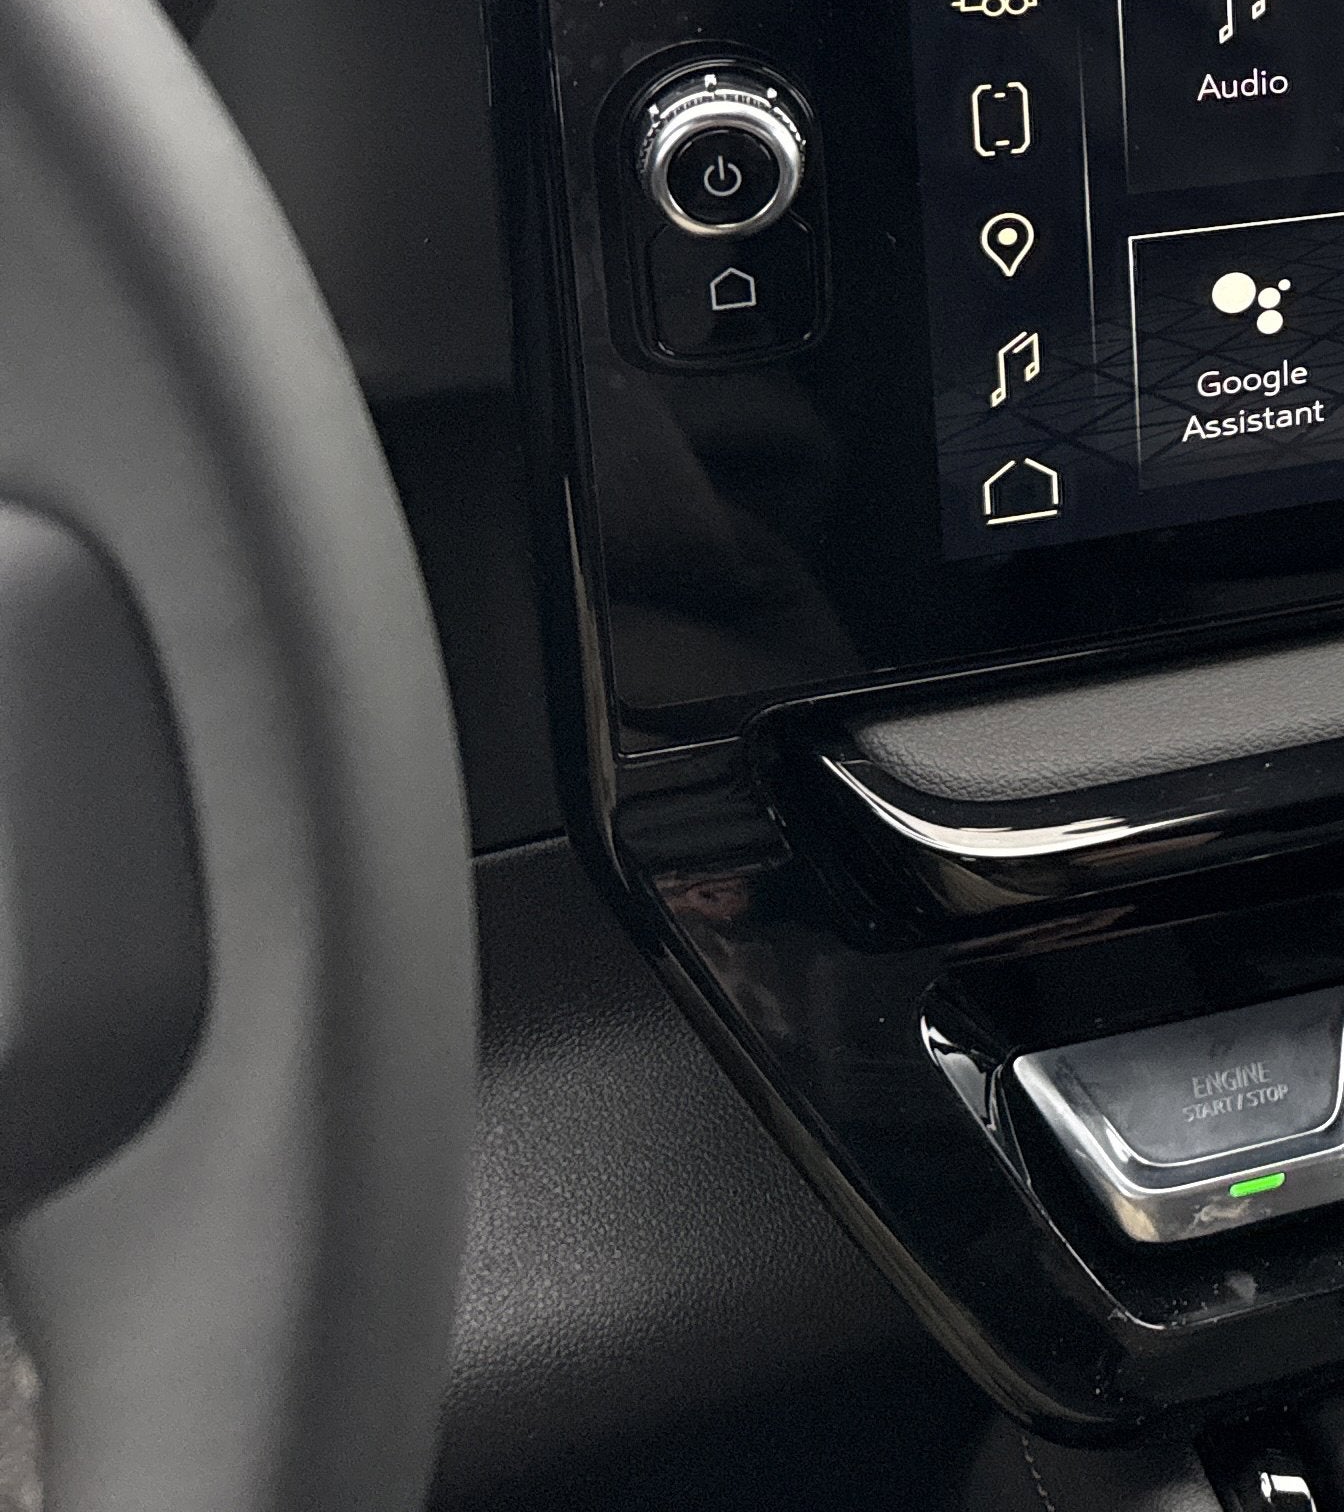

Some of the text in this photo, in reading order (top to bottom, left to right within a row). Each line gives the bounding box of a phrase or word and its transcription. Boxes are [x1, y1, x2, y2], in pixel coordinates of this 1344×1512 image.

[1196, 68, 1290, 102] Audio
[1196, 359, 1309, 399] Google
[1181, 399, 1326, 444] Assistant
[1192, 1062, 1271, 1099] ENGINE
